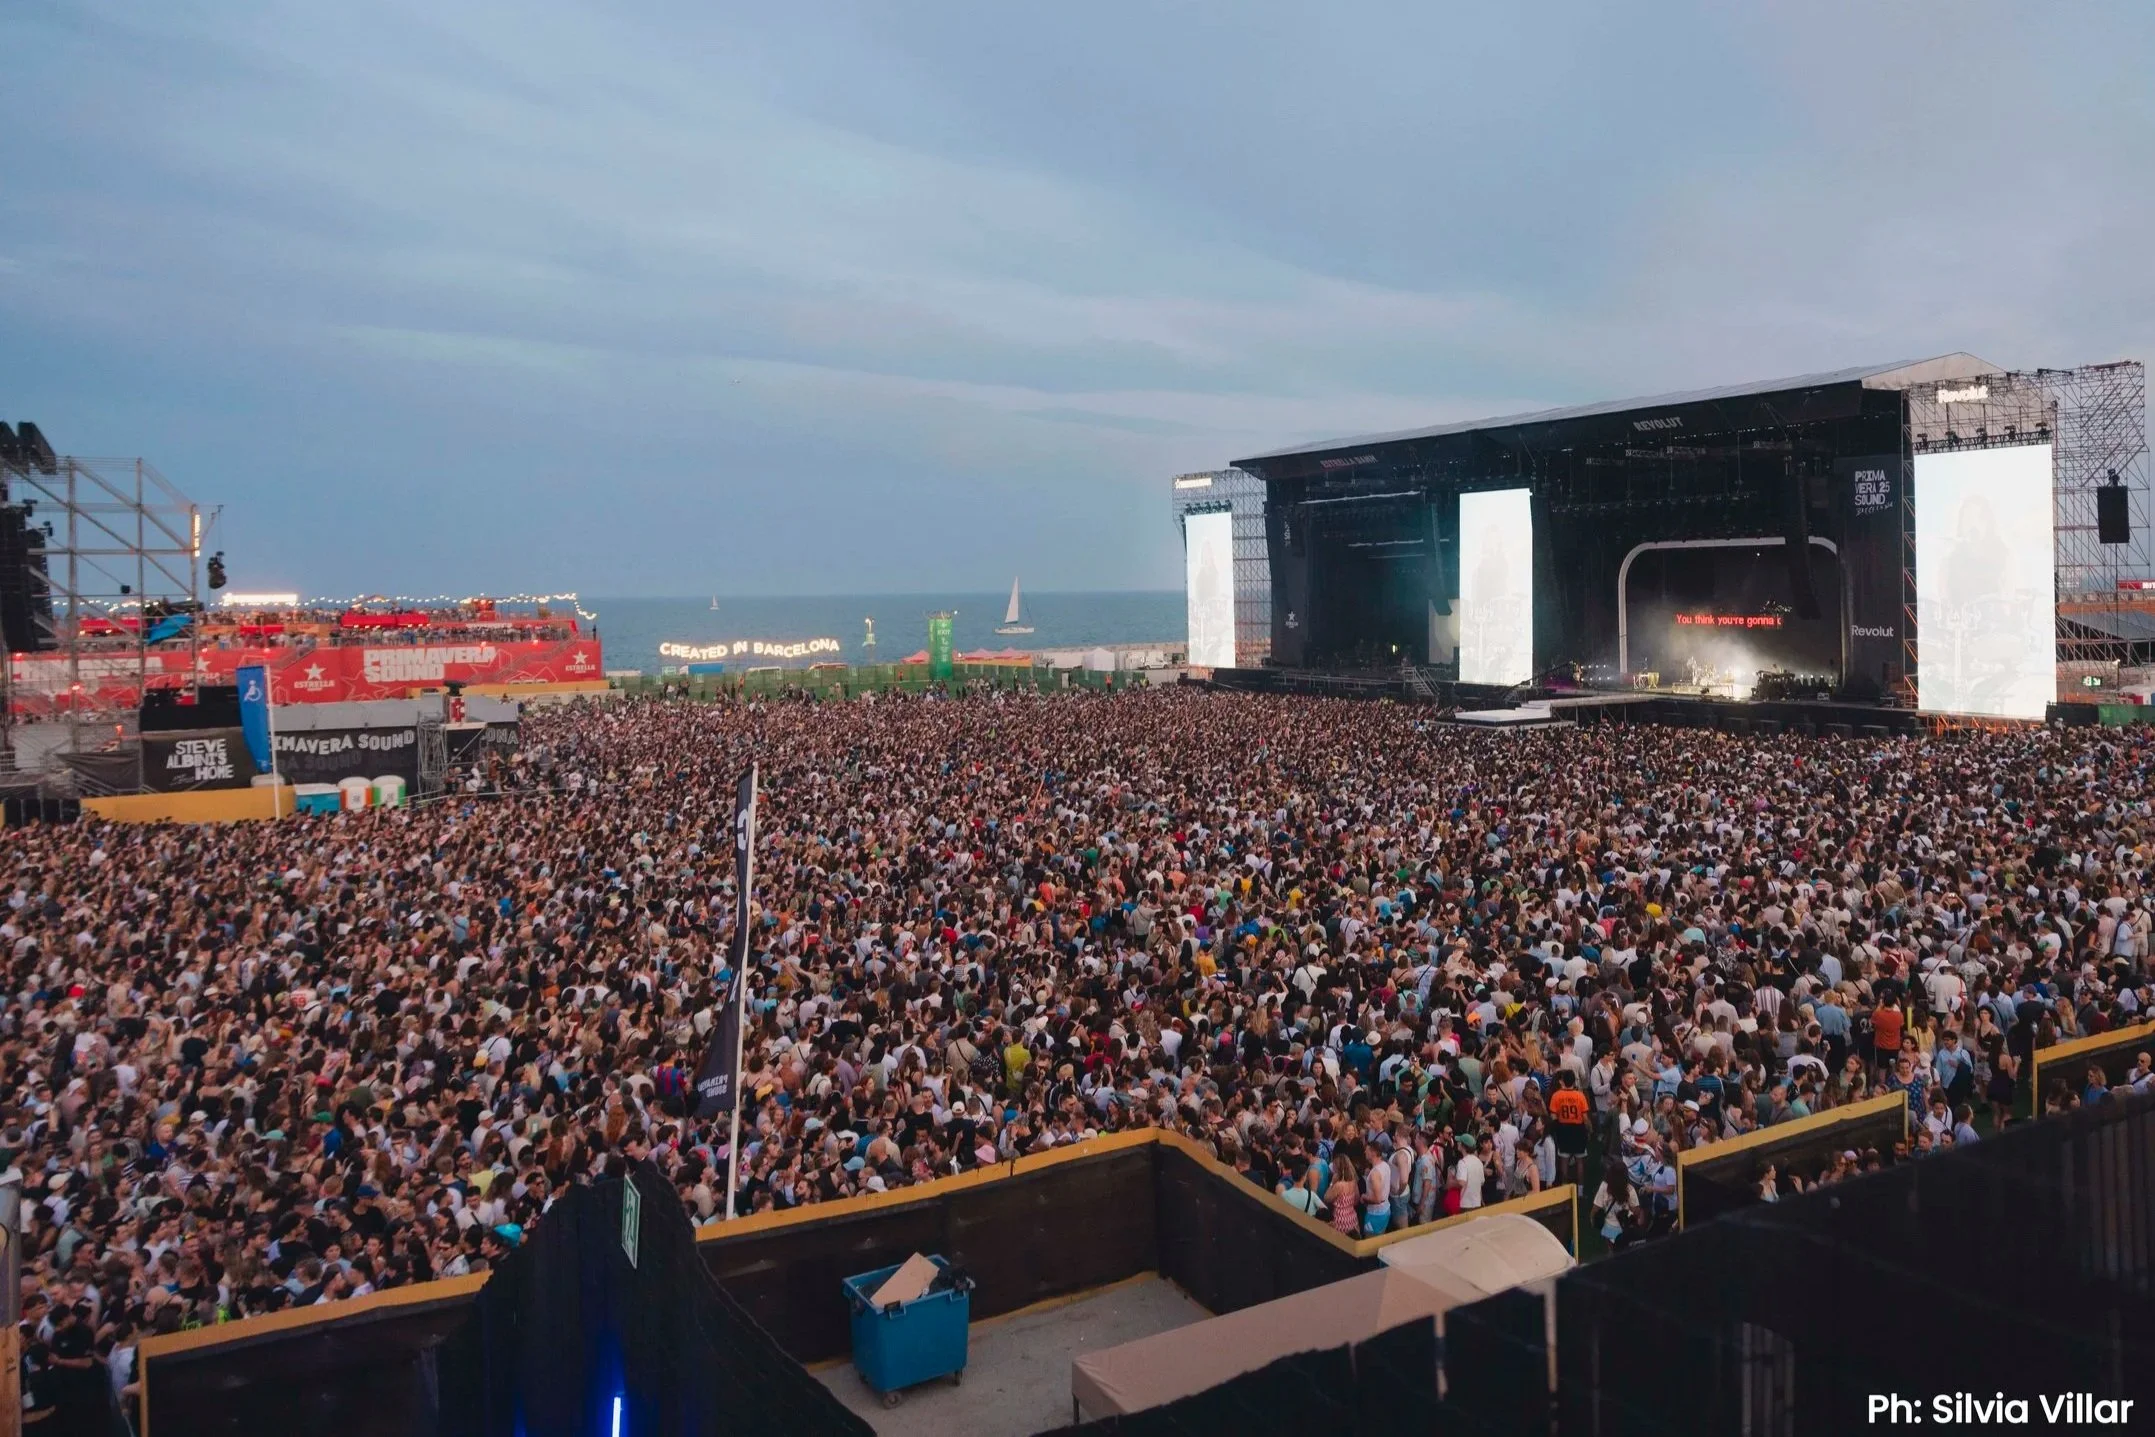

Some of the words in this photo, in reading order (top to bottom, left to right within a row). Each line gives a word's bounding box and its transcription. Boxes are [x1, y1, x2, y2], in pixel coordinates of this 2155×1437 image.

[1633, 416, 1683, 431] REVOLUT
[1855, 470, 1886, 482] PRIMA
[1855, 482, 1877, 494] VERA
[1879, 481, 1891, 493] 25
[1855, 493, 1886, 506] SOUND
[1676, 614, 1692, 624] You
[1695, 615, 1715, 625] think
[1747, 616, 1774, 628] gonna
[1851, 624, 1894, 637] Revolut
[363, 647, 497, 666] PRIMAVERA
[659, 642, 728, 660] CREATED
[733, 640, 748, 655] IN
[753, 638, 840, 658] BARCELONA
[363, 663, 445, 683] SOUND
[175, 739, 227, 755] STEVE
[274, 734, 353, 755] IMAVERA
[357, 729, 415, 751] SOUND
[195, 764, 235, 781] HOME
[1561, 1104, 1578, 1120] 89
